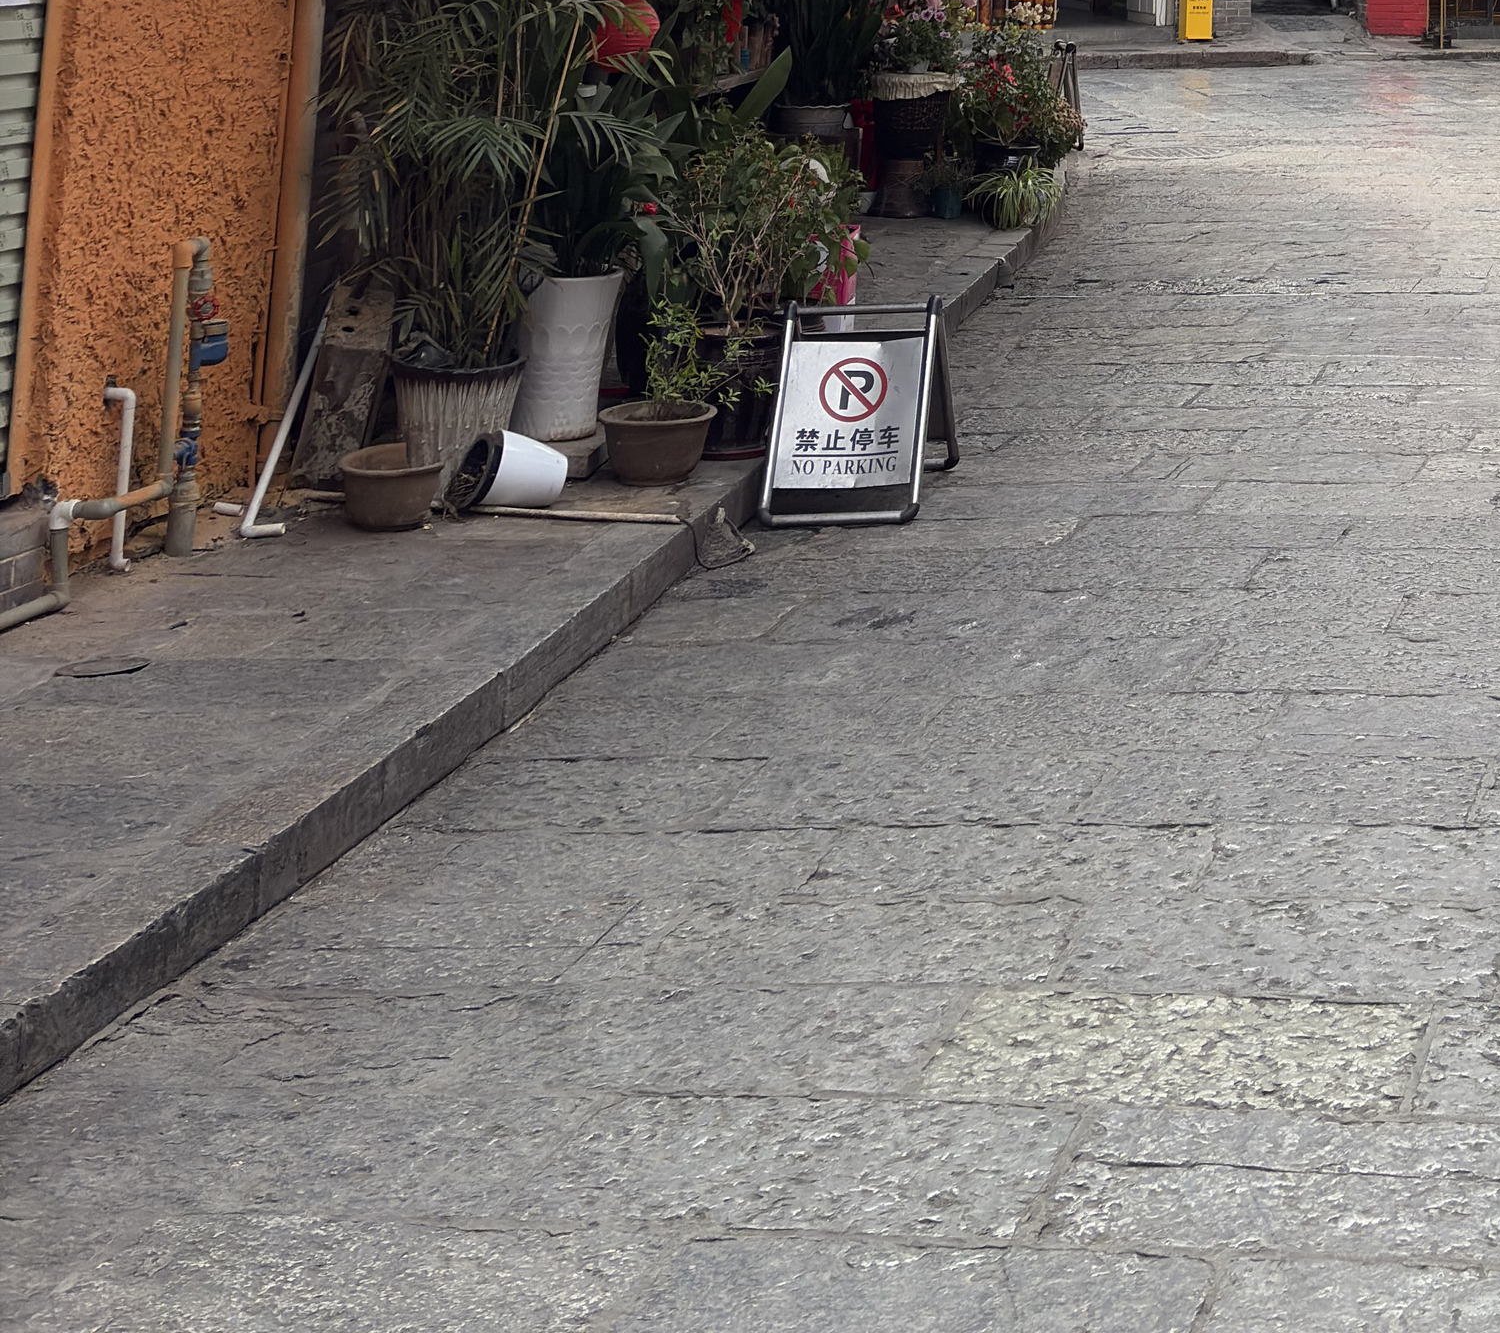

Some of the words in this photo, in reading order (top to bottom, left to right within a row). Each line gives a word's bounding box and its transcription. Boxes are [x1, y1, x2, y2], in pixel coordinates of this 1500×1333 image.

[794, 426, 901, 453] 禁止停车
[790, 459, 815, 476] NO
[822, 455, 898, 476] PARKING
